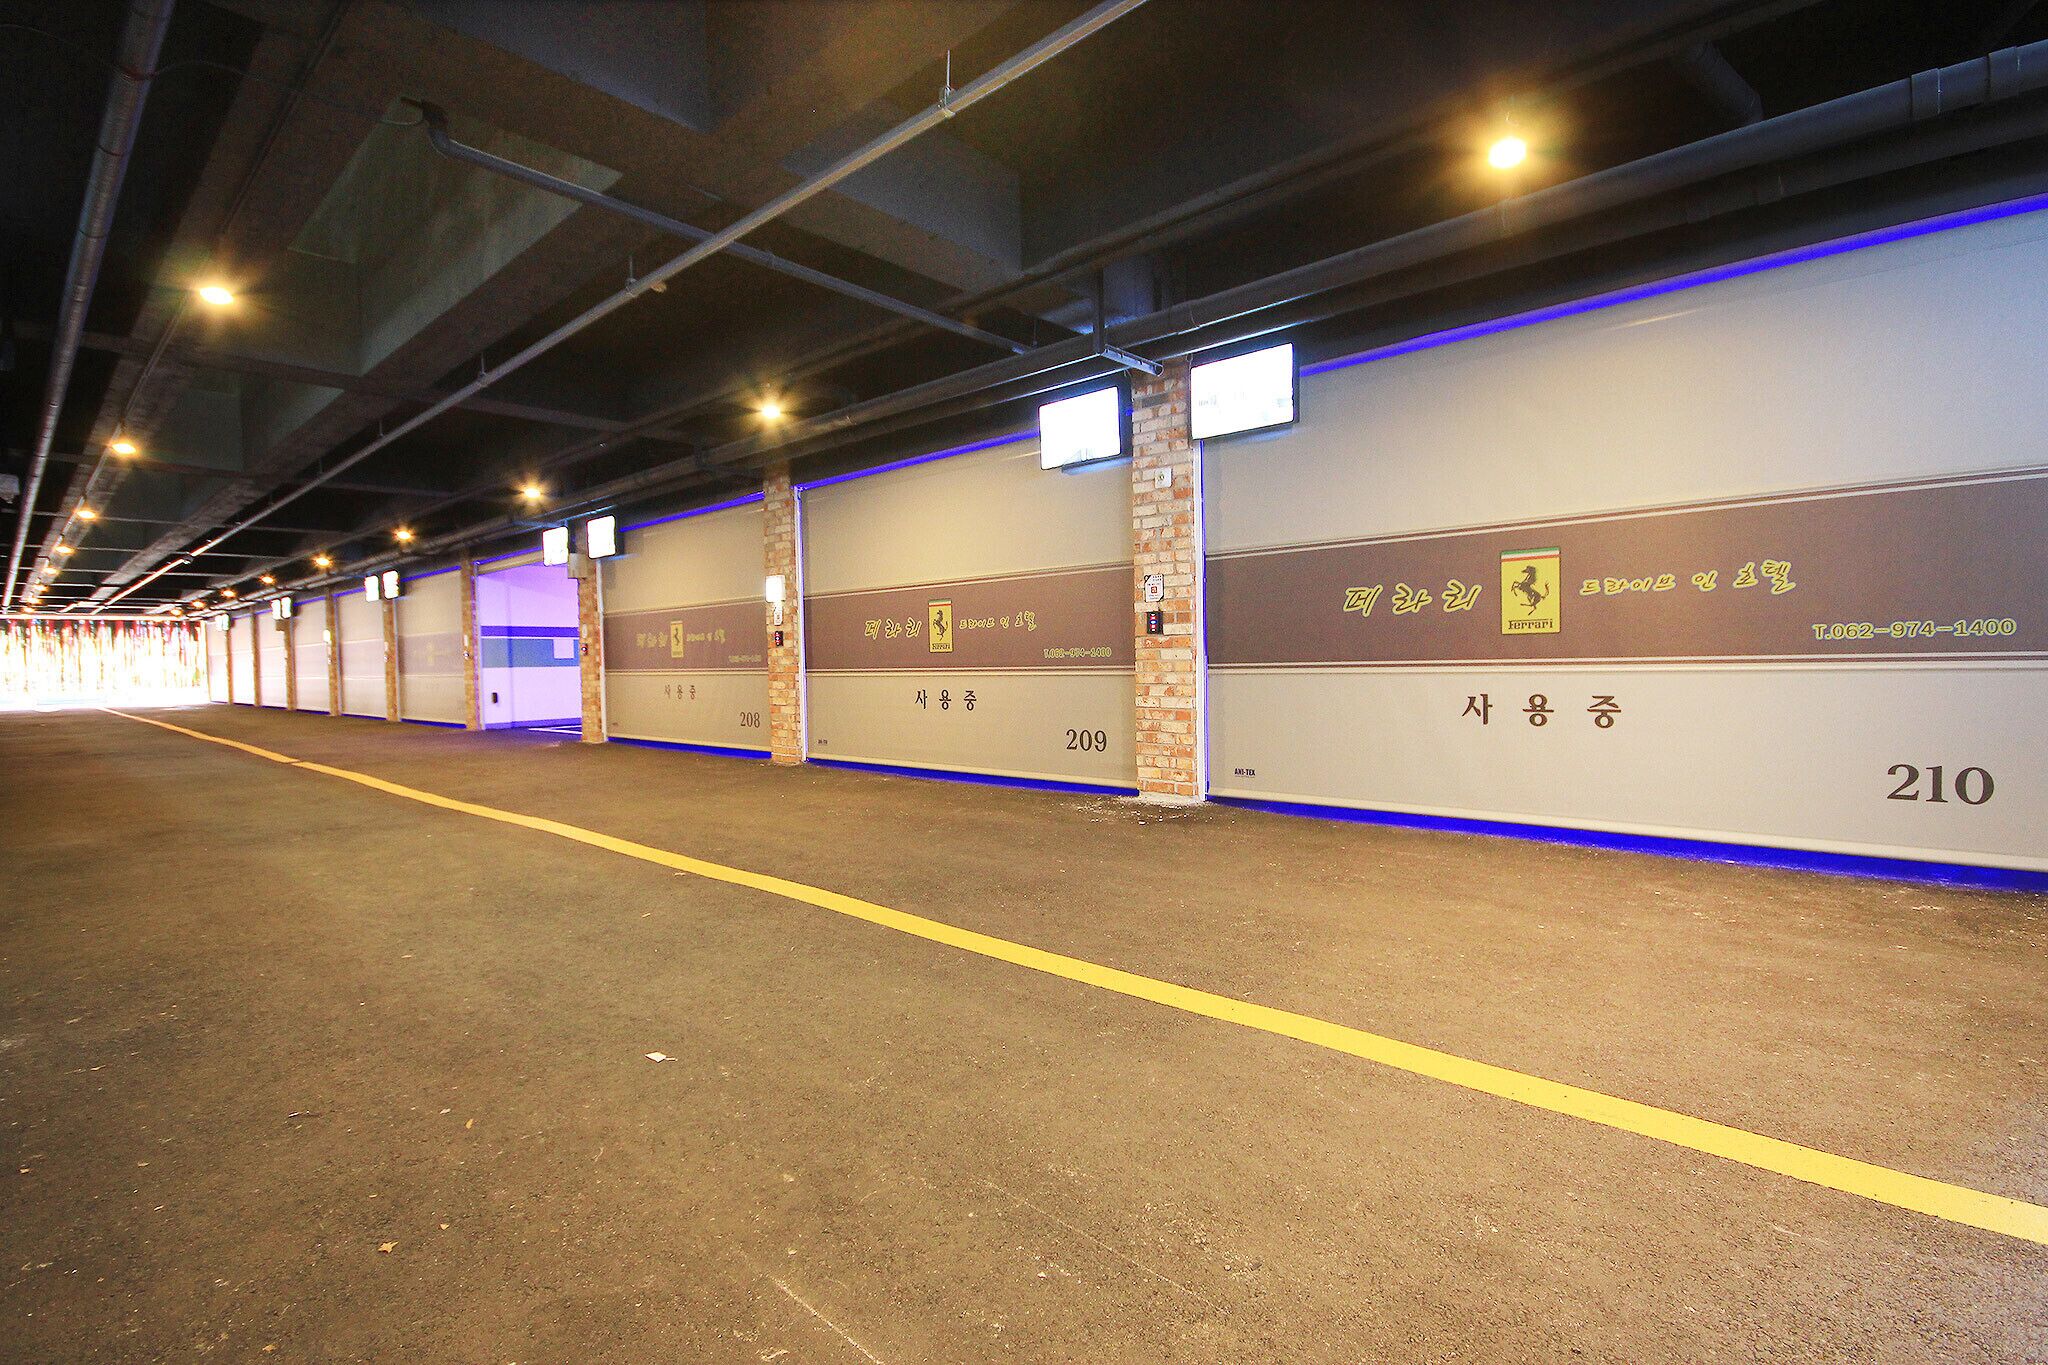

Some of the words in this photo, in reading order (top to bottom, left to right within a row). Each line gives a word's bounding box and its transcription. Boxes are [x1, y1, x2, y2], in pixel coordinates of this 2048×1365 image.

[1579, 572, 1677, 596] 드라이브
[1692, 570, 1718, 592] 인
[1733, 559, 1797, 595] 호텔
[1507, 618, 1554, 630] Ferrari
[1812, 618, 2017, 640] T.062-974-1400
[740, 711, 760, 729] 208
[1065, 728, 1107, 752] 209
[1886, 763, 1995, 805] 210
